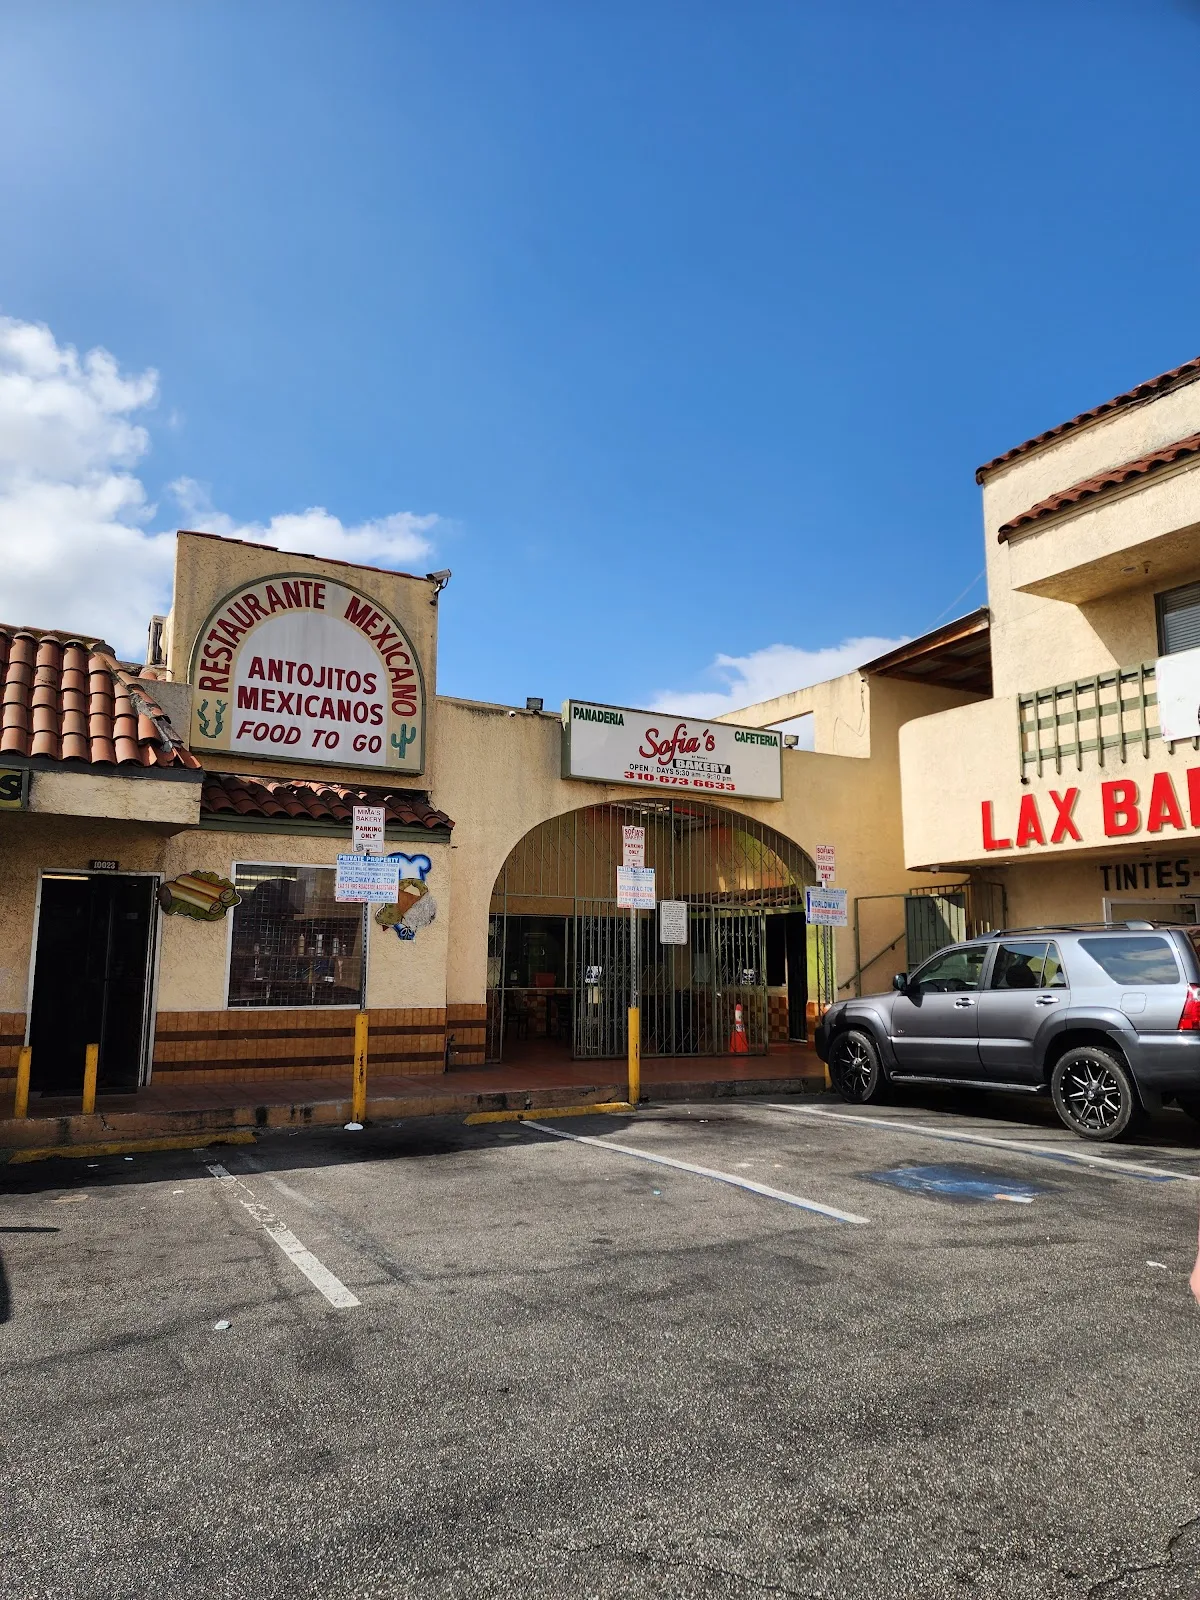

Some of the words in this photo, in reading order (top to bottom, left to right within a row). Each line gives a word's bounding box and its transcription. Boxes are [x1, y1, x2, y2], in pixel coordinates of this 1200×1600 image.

[199, 581, 326, 693] RESTAURANTE
[343, 596, 417, 717] MEXICANO
[248, 656, 377, 695] ANTOJITOS
[237, 686, 384, 726] MEXICANOS
[573, 706, 625, 726] PANADERIA
[236, 720, 301, 745] FOOD
[311, 729, 340, 749] TO
[352, 734, 382, 754] GO
[734, 730, 778, 747] CAFETERIA
[629, 763, 649, 772] OPEN
[656, 766, 674, 775] DAYS
[675, 759, 727, 773] BAKERY
[980, 787, 1081, 852] LAX
[817, 847, 835, 855] SOFIA'S
[94, 861, 116, 870] 10023
[811, 900, 840, 909] WORLDWAY
